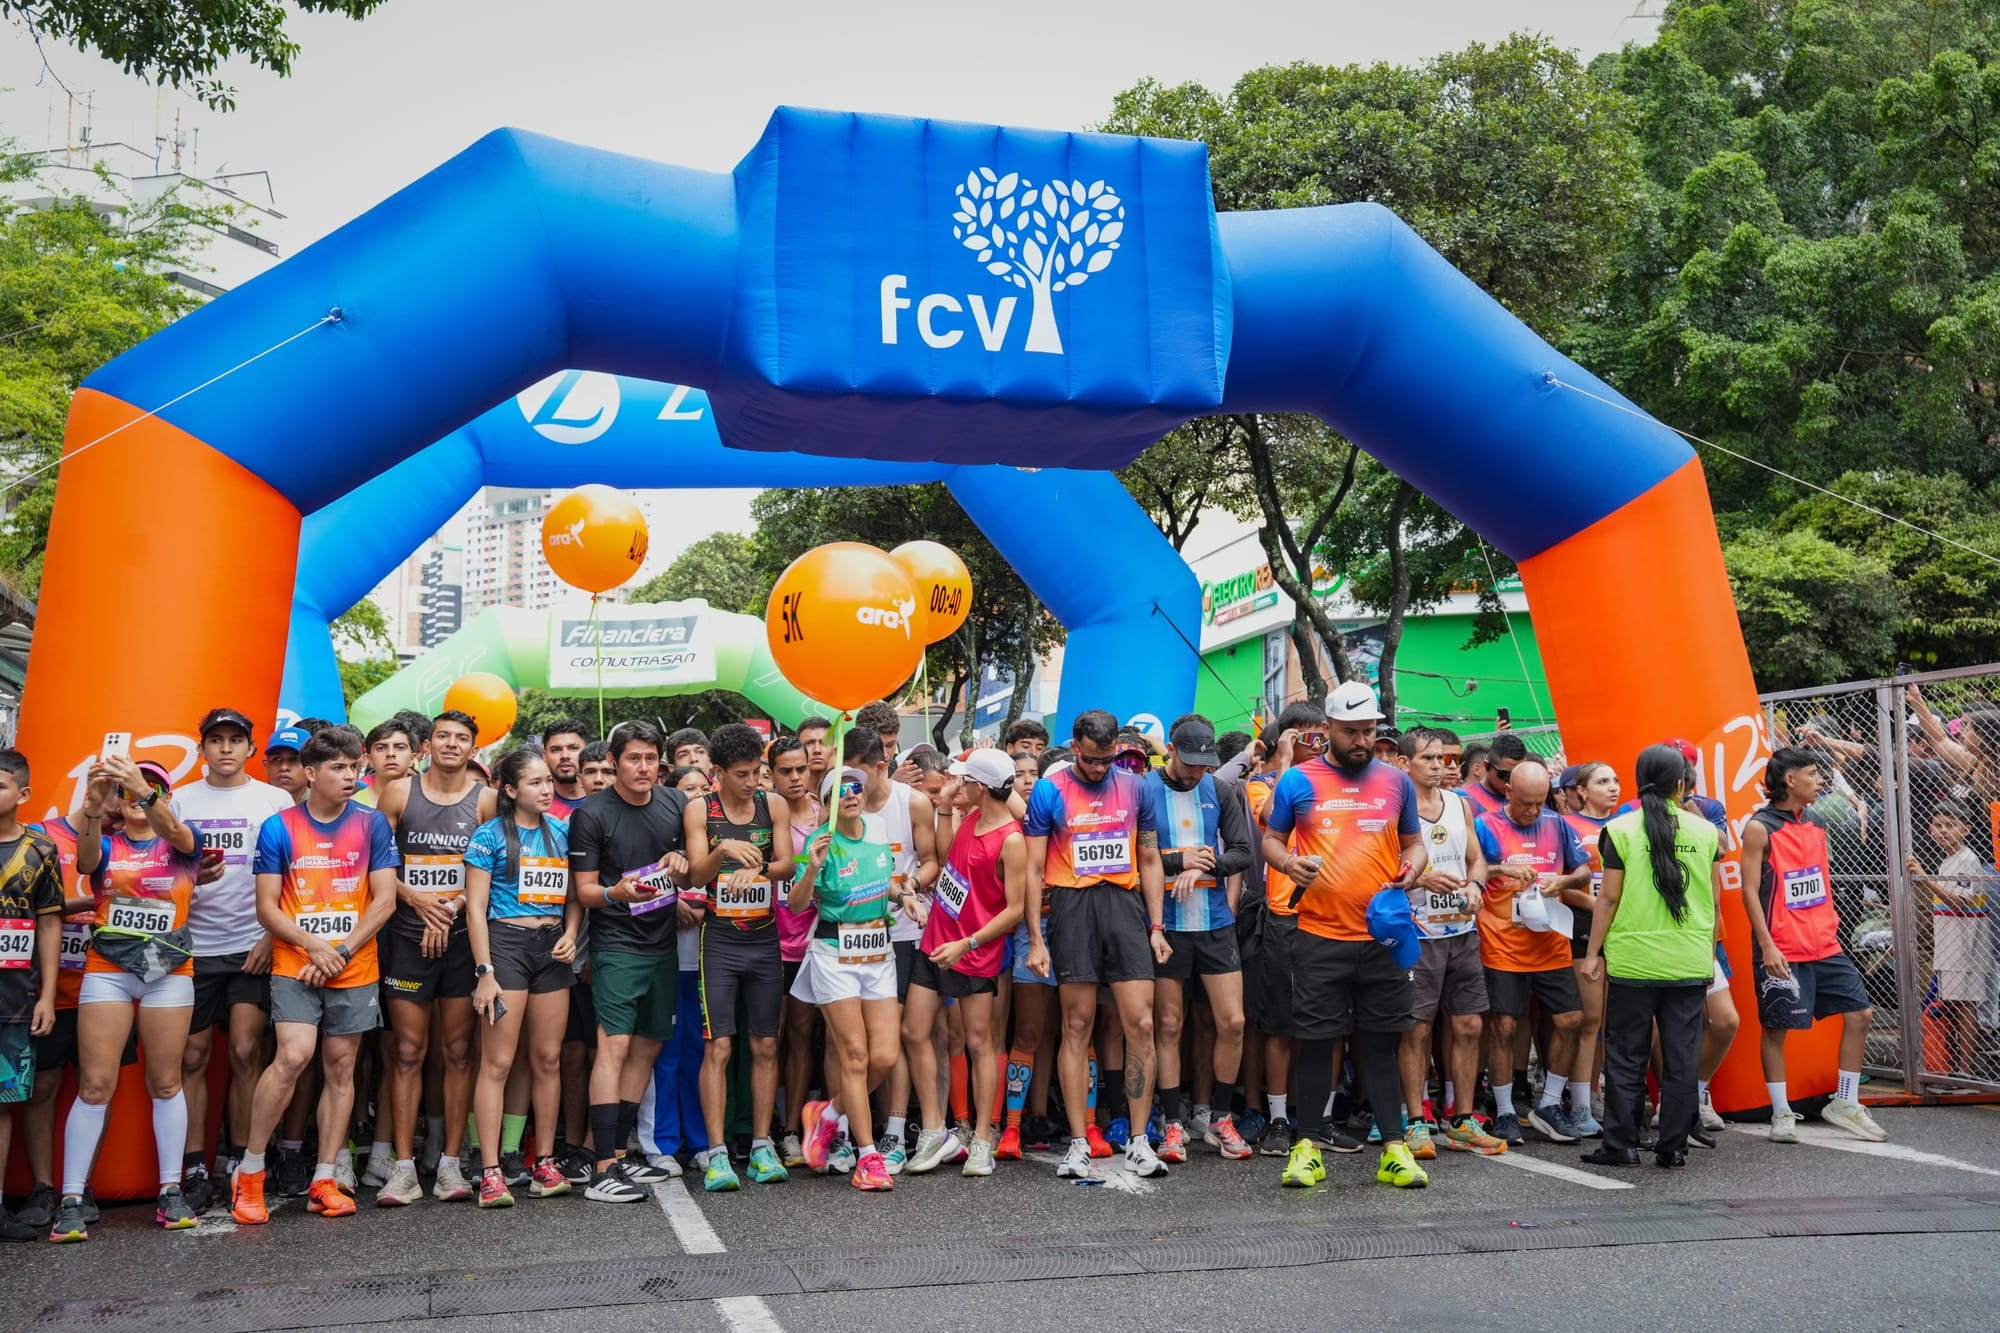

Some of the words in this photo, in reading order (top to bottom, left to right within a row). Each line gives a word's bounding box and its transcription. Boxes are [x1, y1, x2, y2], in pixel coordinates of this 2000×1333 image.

[880, 273, 1018, 352] fcv
[930, 584, 962, 616] 00:40
[782, 591, 804, 644] 5K
[856, 606, 899, 630] ara
[565, 623, 687, 645] Financiera
[203, 832, 244, 849] 9198
[407, 831, 469, 848] RUNNING
[1078, 843, 1124, 862] 56792
[408, 868, 458, 886] 53126
[523, 871, 564, 889] 54273
[939, 872, 965, 906] 58696
[112, 909, 169, 932] 63356
[299, 915, 352, 935] 52546
[843, 932, 885, 950] 64608
